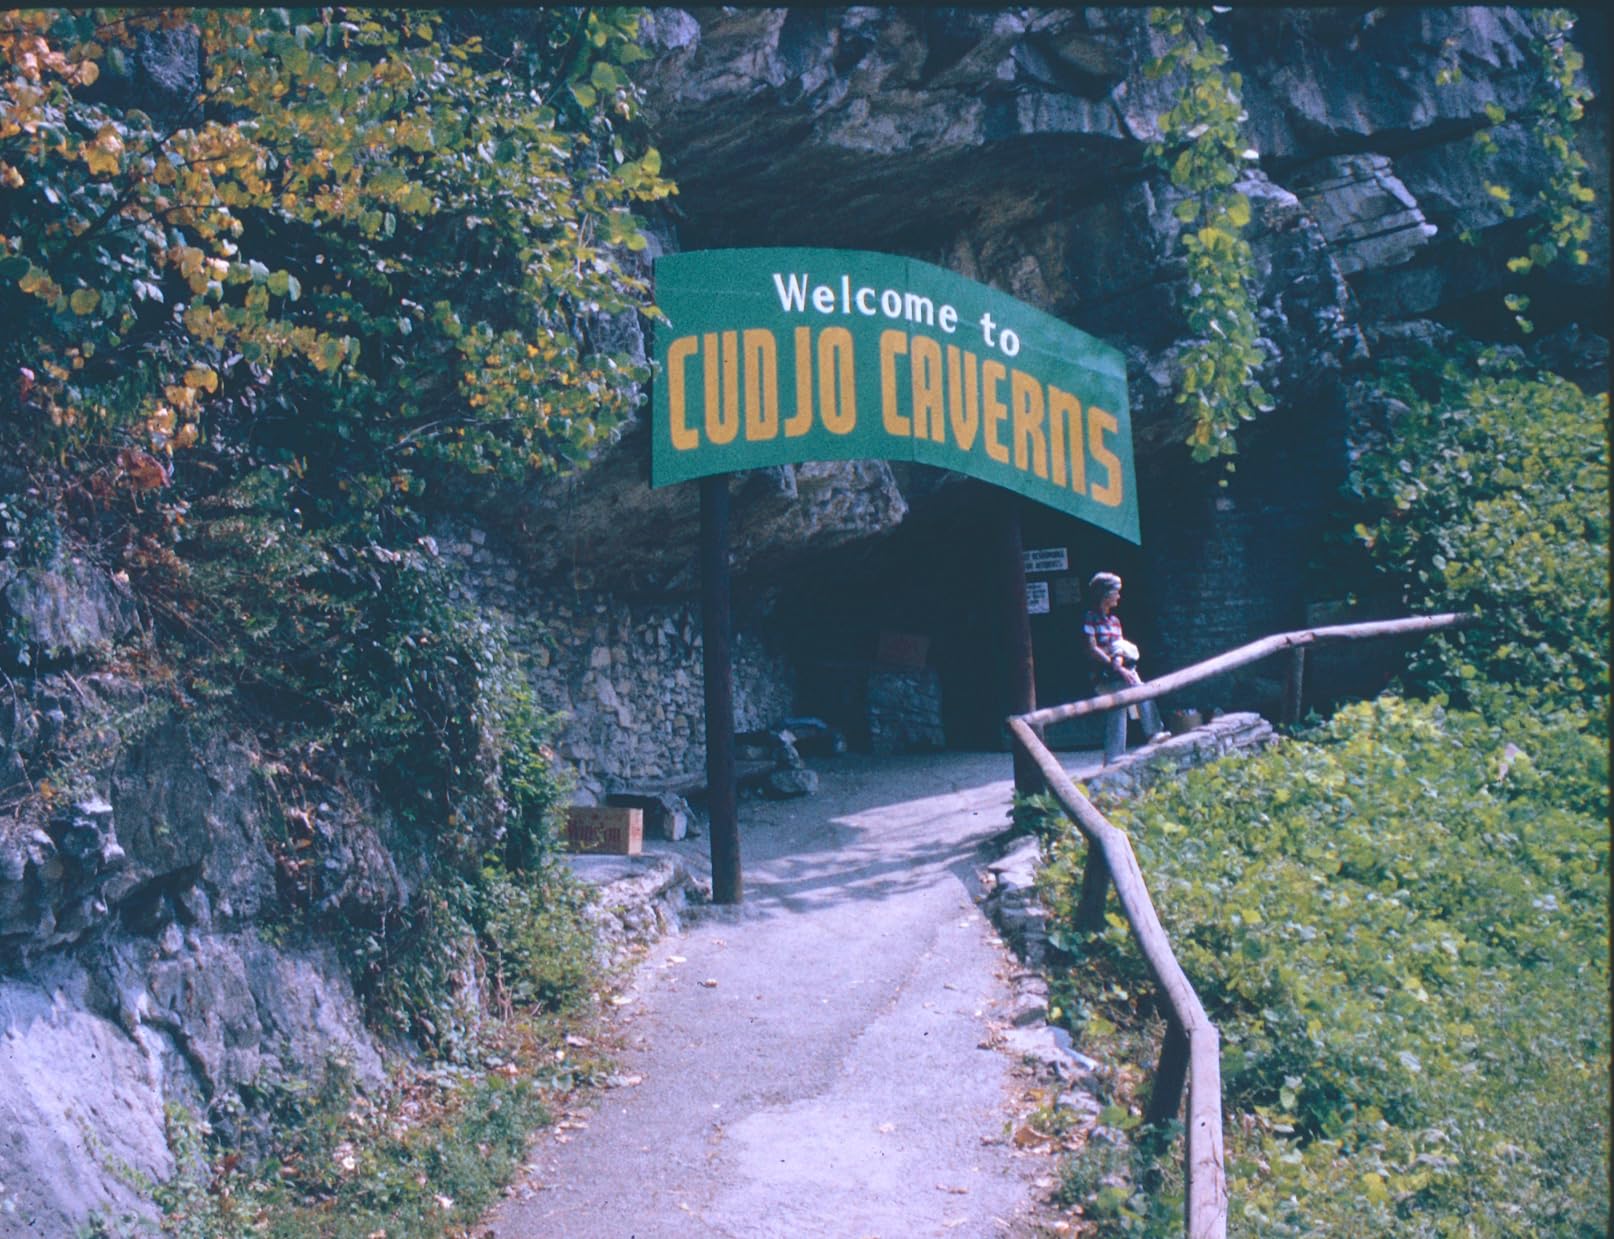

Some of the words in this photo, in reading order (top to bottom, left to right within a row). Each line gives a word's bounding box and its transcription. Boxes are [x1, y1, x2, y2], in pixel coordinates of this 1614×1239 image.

[772, 272, 959, 333] Welcome
[979, 311, 1021, 358] to
[667, 325, 857, 451] CUDJO
[879, 327, 1124, 508] CAVERNS
